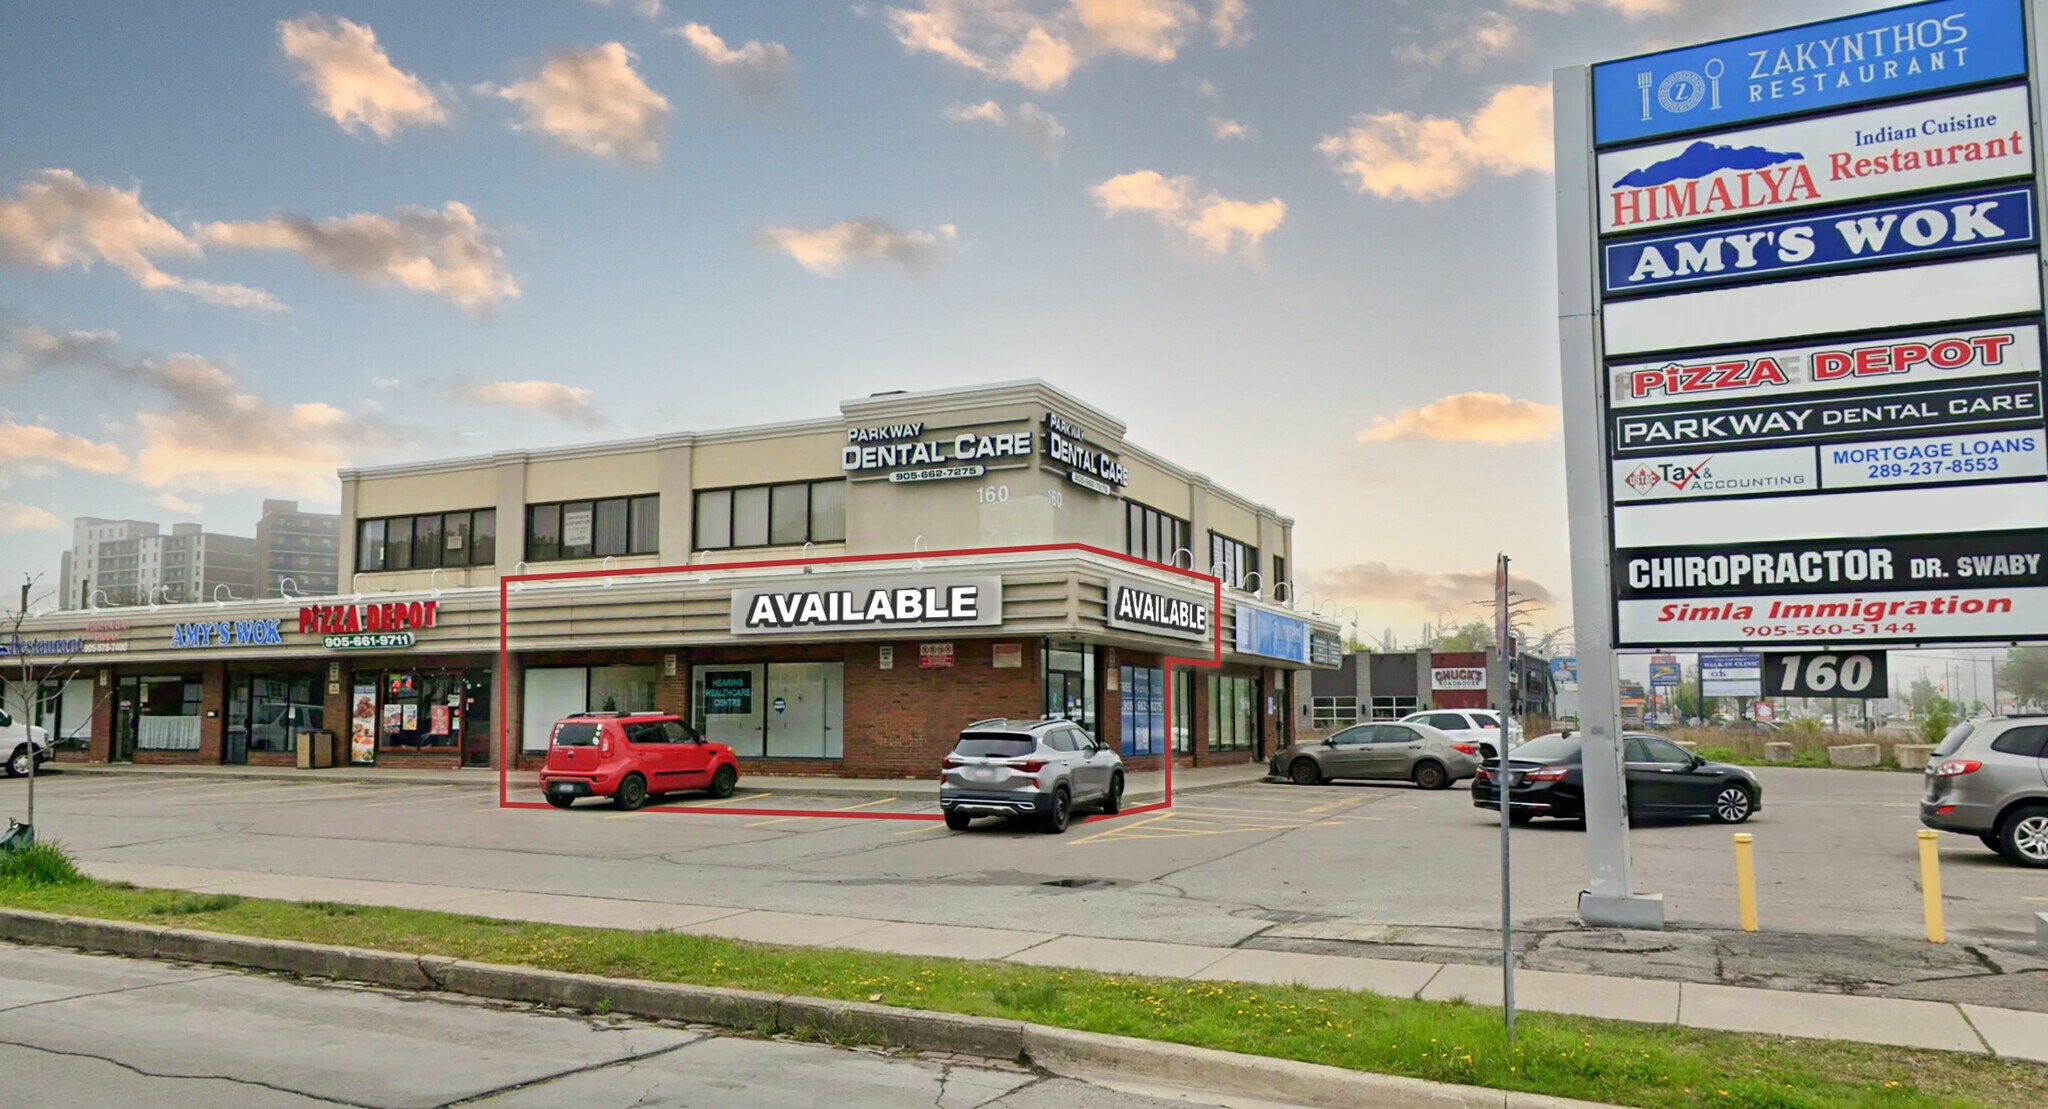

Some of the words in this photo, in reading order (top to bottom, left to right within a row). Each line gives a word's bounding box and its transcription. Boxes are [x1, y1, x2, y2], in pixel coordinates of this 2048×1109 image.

[1748, 13, 1967, 79] ZAKYNTHOS
[1749, 47, 1968, 102] RESTAURANT
[1855, 125, 1916, 146] Indian
[1921, 113, 1997, 136] Cuisine
[1829, 130, 2023, 181] Restaurant
[1610, 164, 1821, 227] HIMALYA
[1628, 226, 1815, 282] AMY'S
[1835, 201, 2005, 256] WOK
[1811, 334, 2014, 382] DEPOT
[848, 423, 923, 442] PARKWAY
[1050, 413, 1084, 441] PARKWAY
[1624, 409, 1813, 444] PARKWAY
[1823, 402, 1938, 425] DENTAL
[1949, 393, 2034, 415] CARE
[842, 441, 945, 470] DENTAL
[955, 432, 1032, 460] CARE
[1050, 431, 1097, 474] DENTAL
[1833, 443, 1953, 464] MORTGAGE
[1961, 437, 2035, 456] LOANS
[1100, 453, 1128, 486] CARE
[1658, 464, 1701, 482] Tax
[1869, 457, 1999, 479] 289-237-8553
[976, 485, 1009, 503] 160
[1691, 475, 1805, 490] ACCOUNTING
[1047, 489, 1062, 508] 160
[1629, 548, 1893, 589] CHIROPRACTOR
[1911, 557, 1950, 579] DR.
[1957, 553, 2041, 577] SWABY
[366, 601, 439, 633] DEPOT
[747, 586, 978, 627] AVAILABLE
[1115, 587, 1206, 634] AVAILABLE
[1657, 603, 1753, 622] Simla
[1768, 596, 2012, 622] Immigration
[170, 620, 231, 647] AMY'S
[235, 619, 282, 645] WOK
[324, 634, 409, 647] 905-661-9711
[1742, 622, 1916, 637] 905-560-5144
[712, 678, 743, 687] HEARING
[1779, 655, 1873, 692] 160
[705, 688, 751, 697] HEALTHCARE
[714, 698, 741, 707] CENTRE
